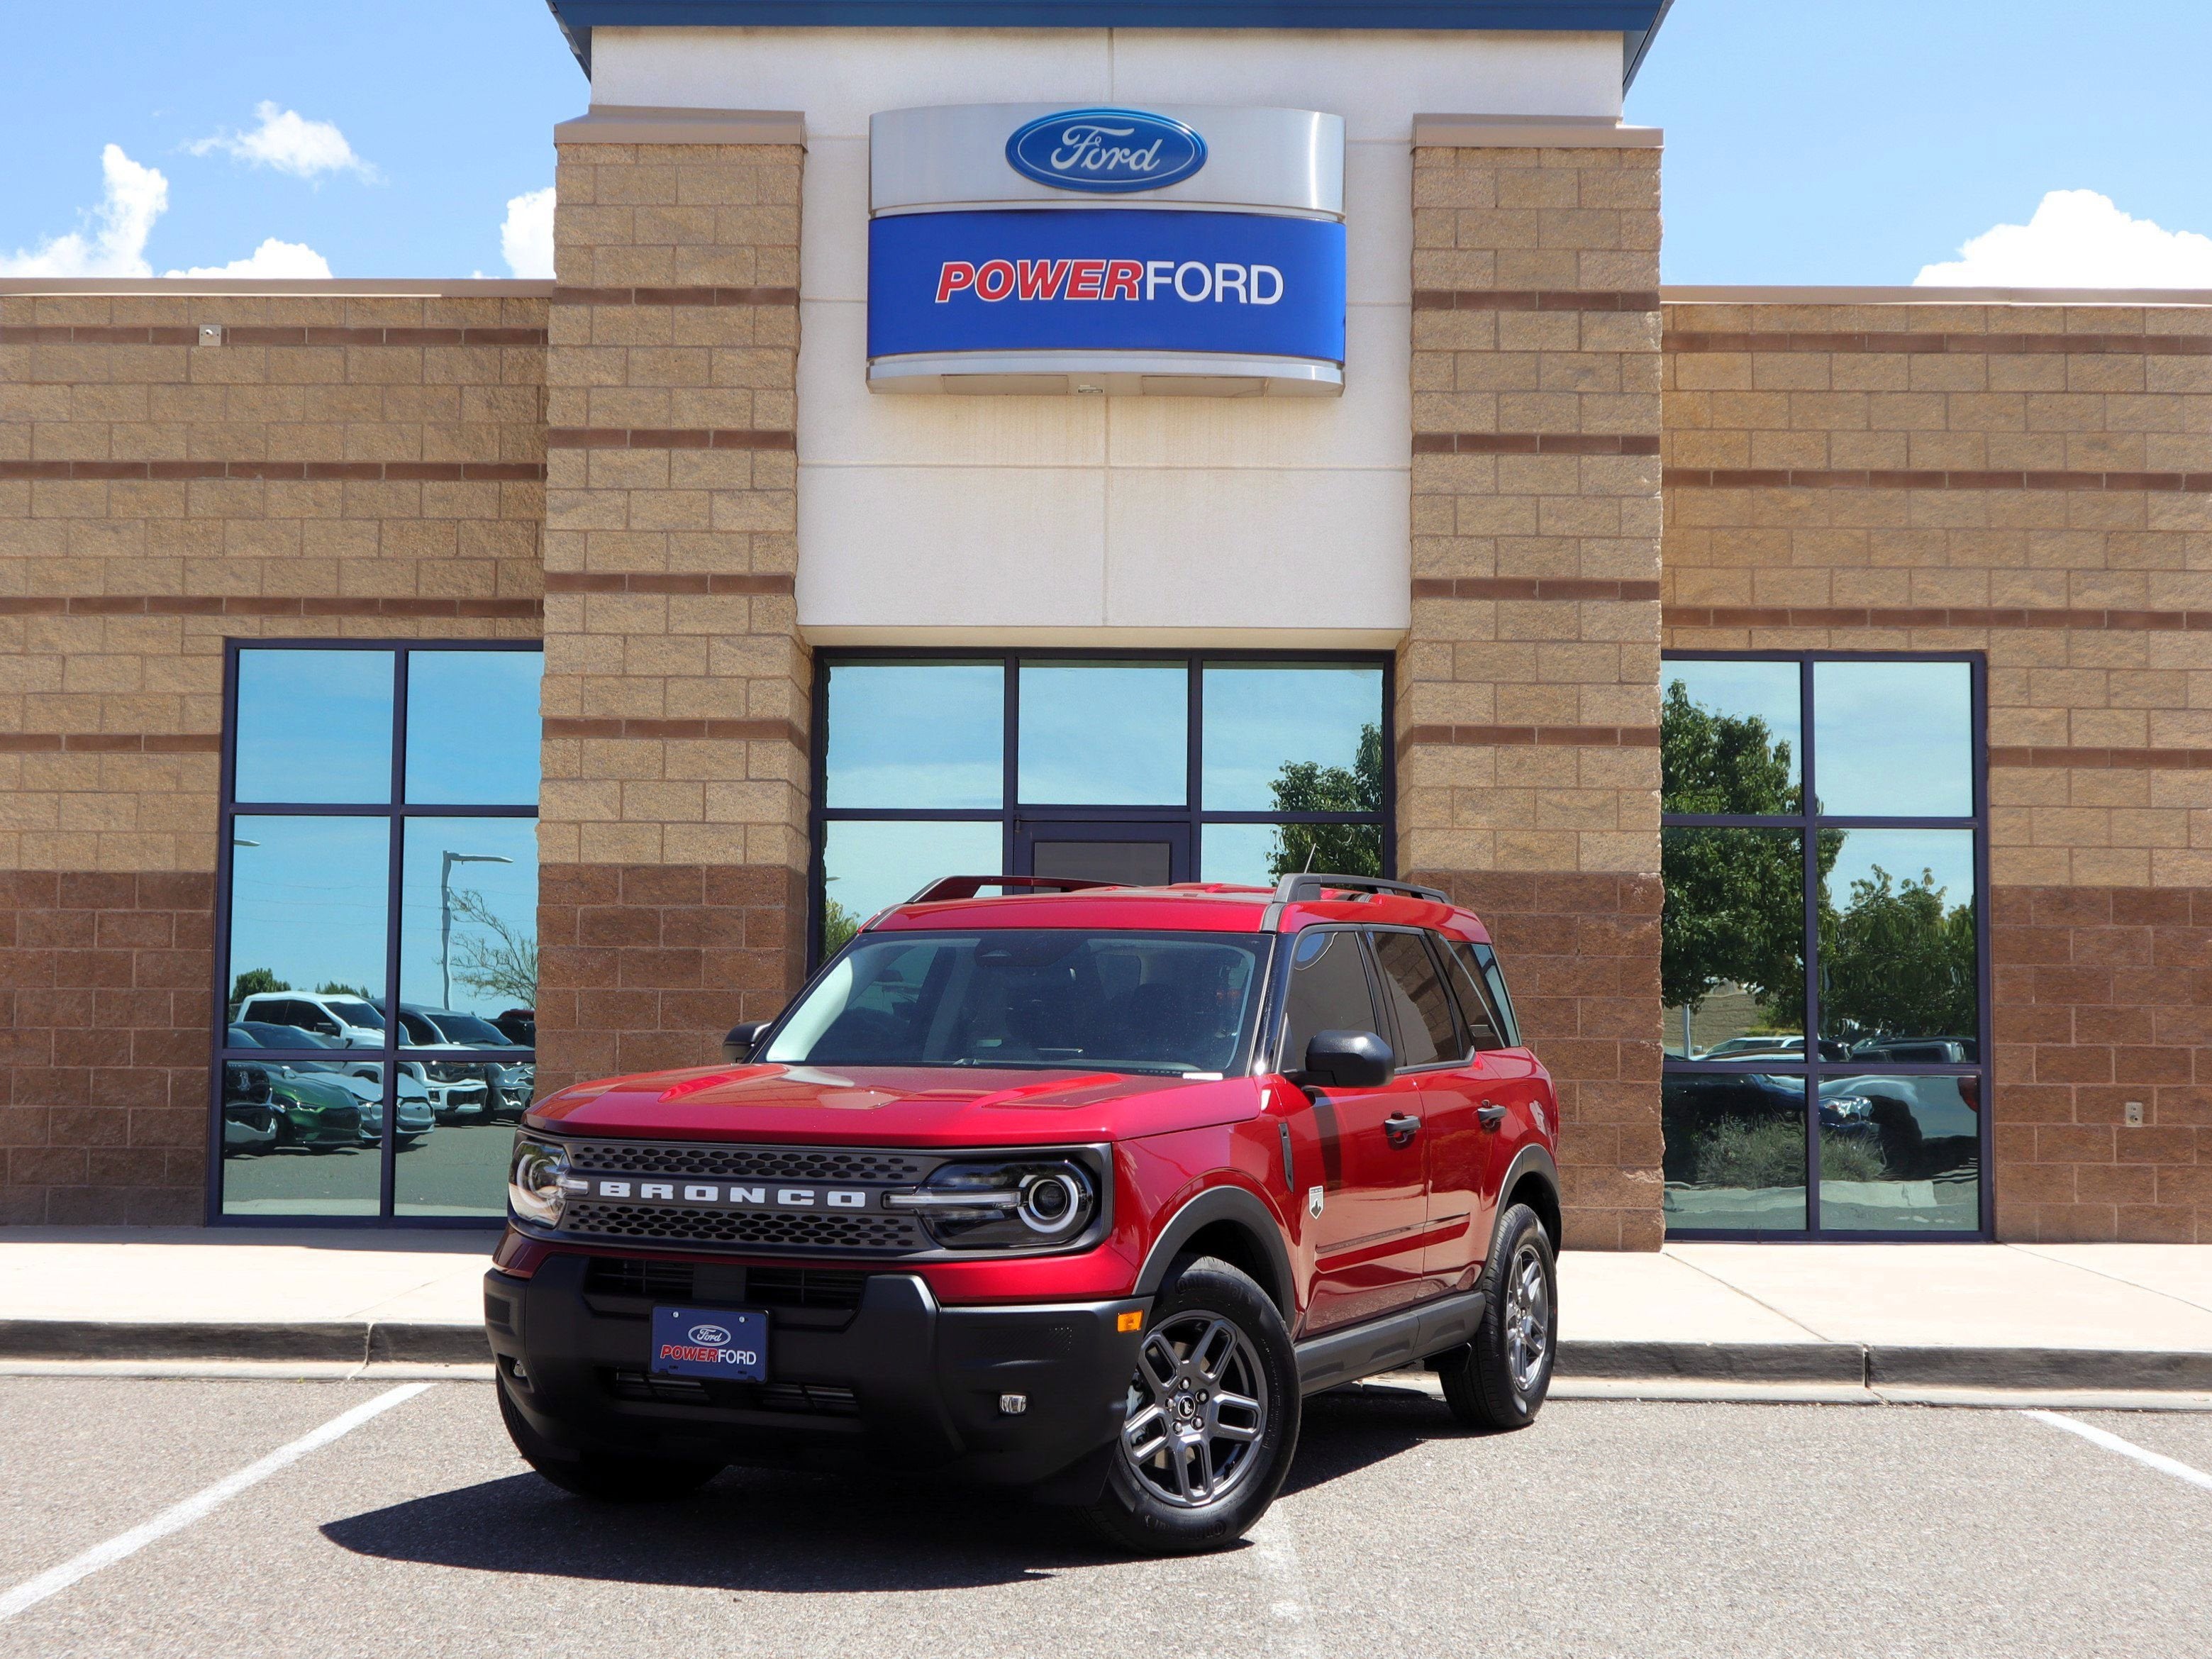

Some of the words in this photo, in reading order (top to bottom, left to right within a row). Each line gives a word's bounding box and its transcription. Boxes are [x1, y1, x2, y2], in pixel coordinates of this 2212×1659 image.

[1051, 126, 1162, 171] Ford
[599, 1181, 866, 1207] BRONCO
[696, 1328, 722, 1342] Ford
